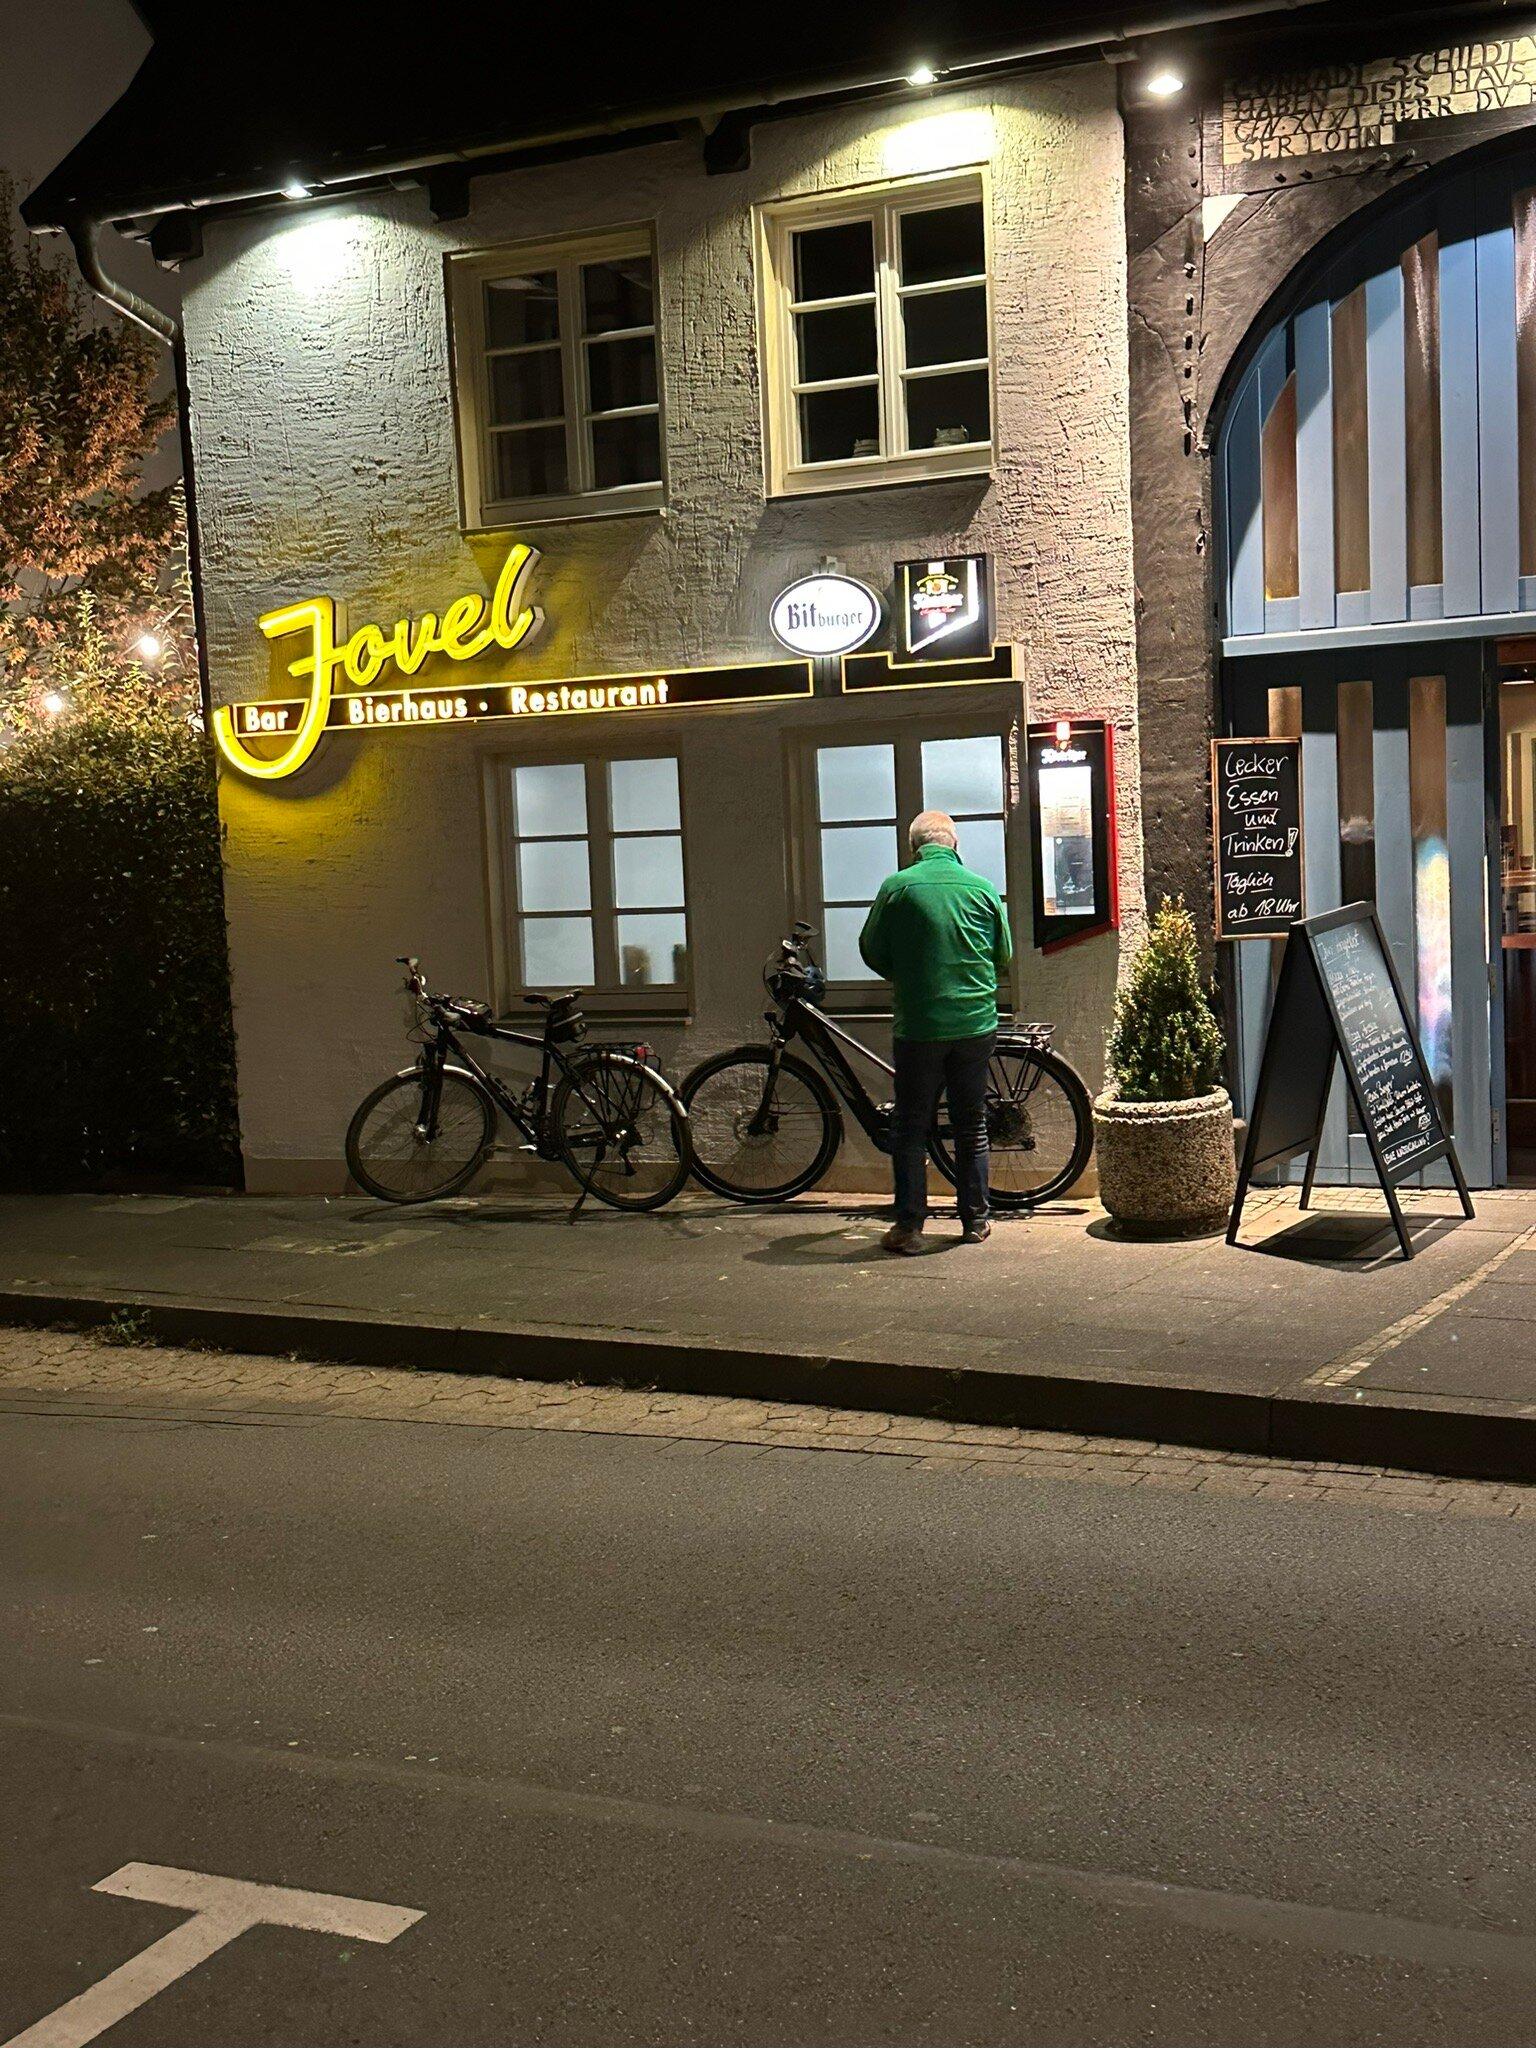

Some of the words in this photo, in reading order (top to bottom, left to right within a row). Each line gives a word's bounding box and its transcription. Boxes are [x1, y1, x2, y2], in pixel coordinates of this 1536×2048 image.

[1349, 78, 1429, 107] DISES
[1450, 62, 1526, 94] HAVS
[1380, 95, 1454, 125] HERR
[786, 602, 864, 631] Bitburger
[213, 543, 538, 779] Jovel
[349, 698, 468, 725] Bierhaus
[511, 679, 668, 714] Restaurant
[245, 706, 288, 732] Bar
[1225, 752, 1289, 777] Lecker
[1226, 785, 1279, 810] Essen
[1223, 828, 1299, 857] Trinken!
[1227, 903, 1248, 919] ab
[1255, 898, 1275, 916] 18
[1276, 898, 1300, 914] Uhr
